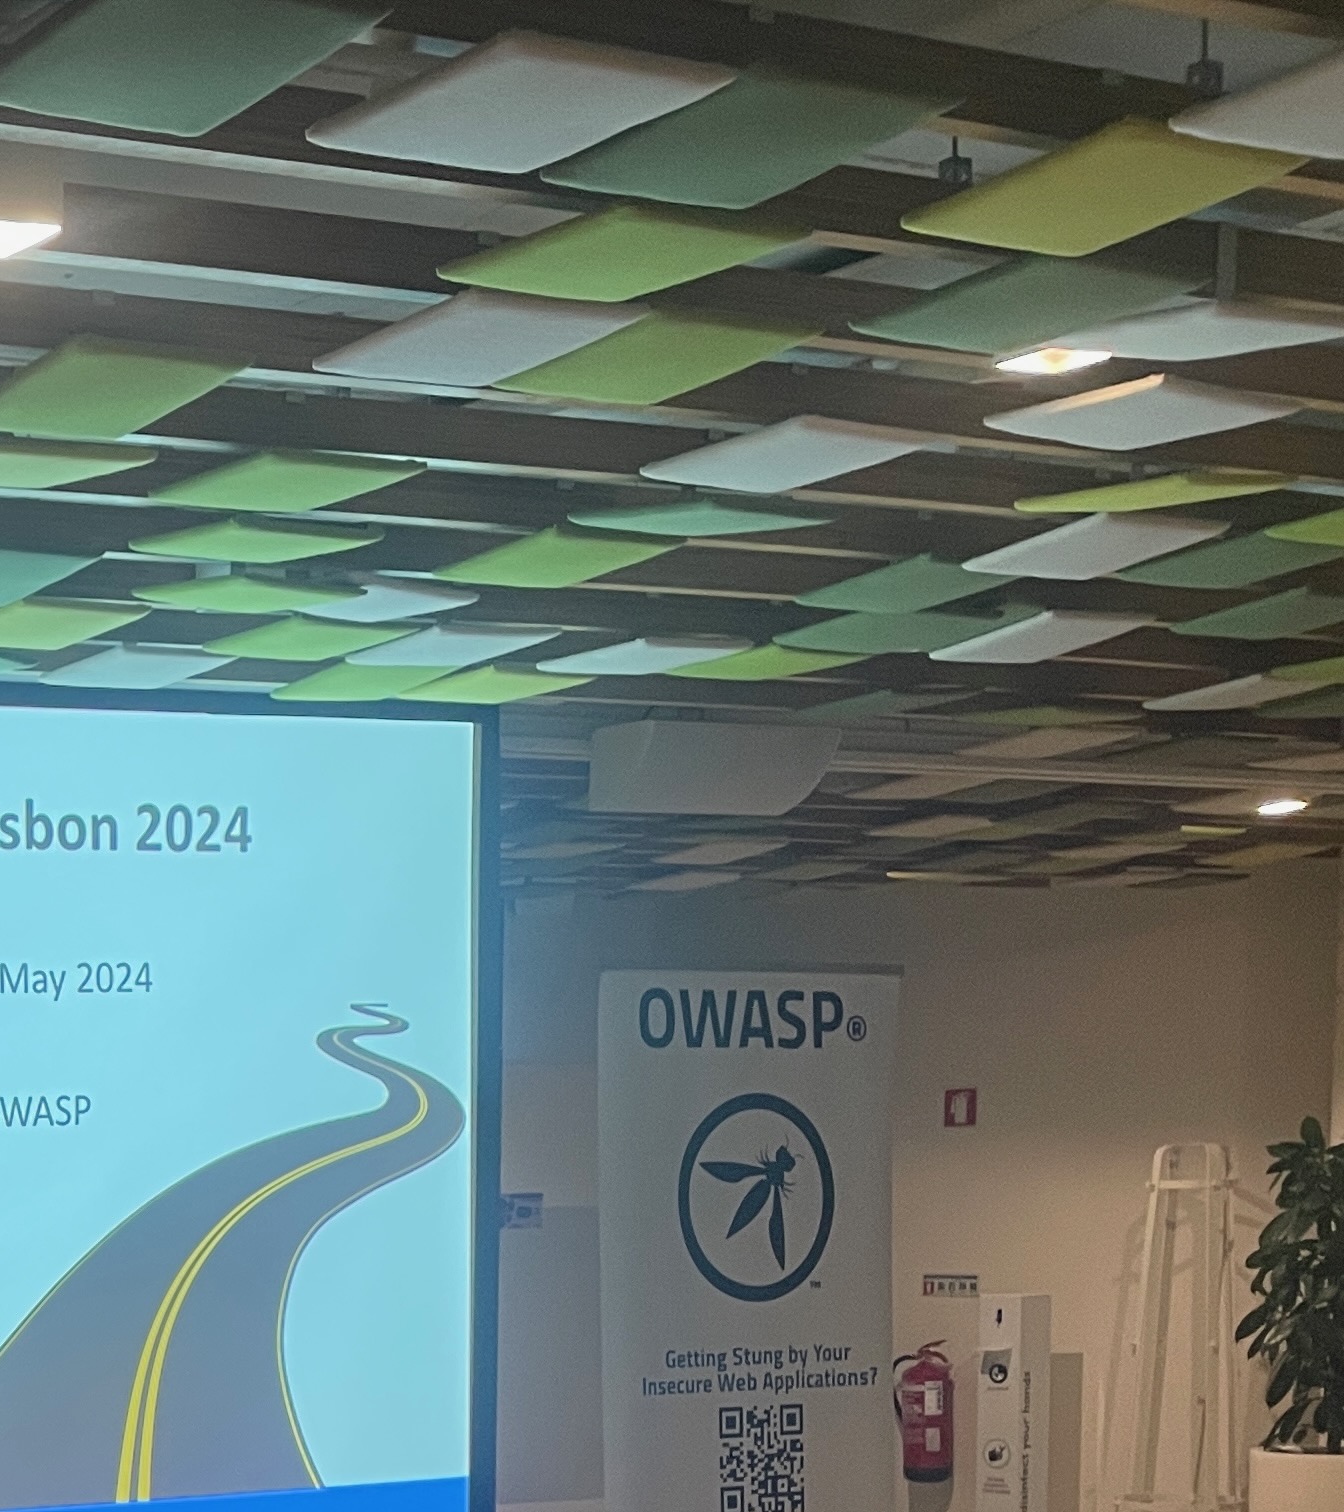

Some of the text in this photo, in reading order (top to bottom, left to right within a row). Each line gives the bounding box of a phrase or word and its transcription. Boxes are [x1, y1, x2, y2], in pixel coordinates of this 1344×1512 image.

[135, 803, 253, 853] 2024
[76, 961, 154, 995] 2024
[665, 1343, 852, 1372] Getting Stung by Your
[642, 1366, 878, 1396] Insecure Web Applications?
